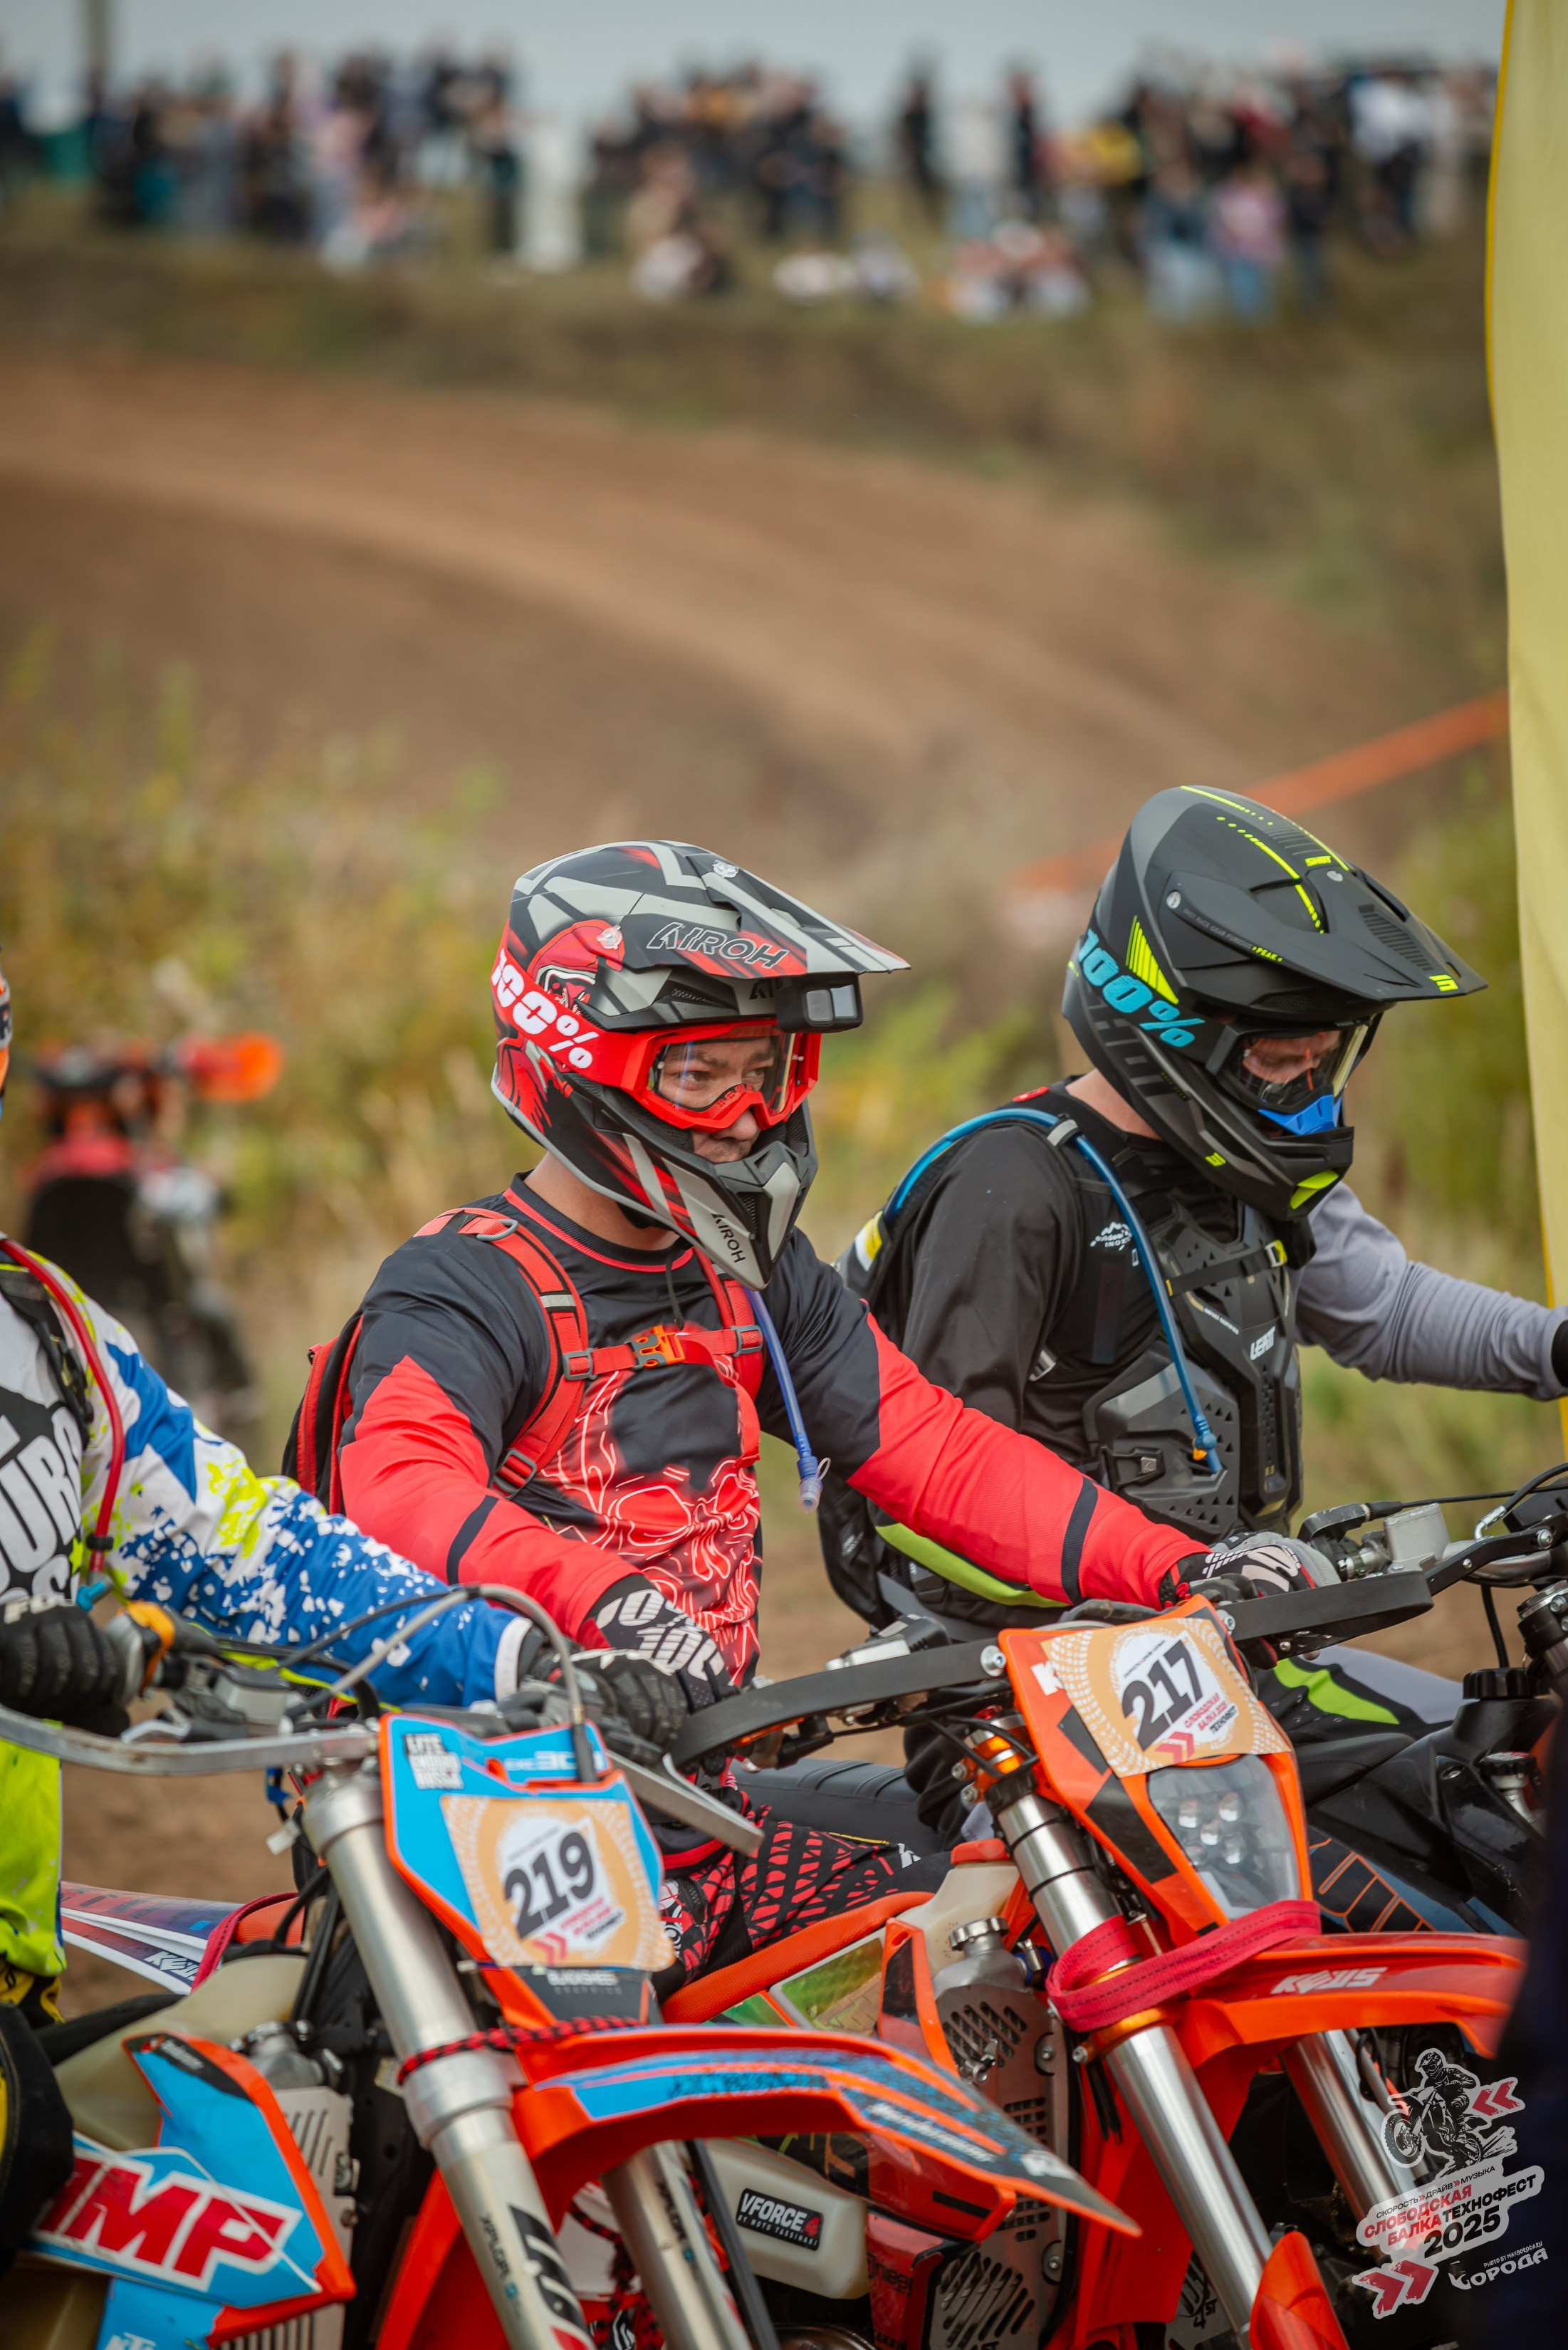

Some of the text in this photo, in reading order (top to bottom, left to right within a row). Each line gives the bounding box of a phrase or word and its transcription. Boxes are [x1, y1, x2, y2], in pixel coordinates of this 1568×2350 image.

[646, 921, 790, 969] AIROH
[1078, 929, 1206, 1048] 100%
[491, 948, 599, 1069] 100%
[711, 1213, 746, 1263] AIROH
[1122, 1639, 1203, 1752] 217
[504, 1832, 594, 1940] 219
